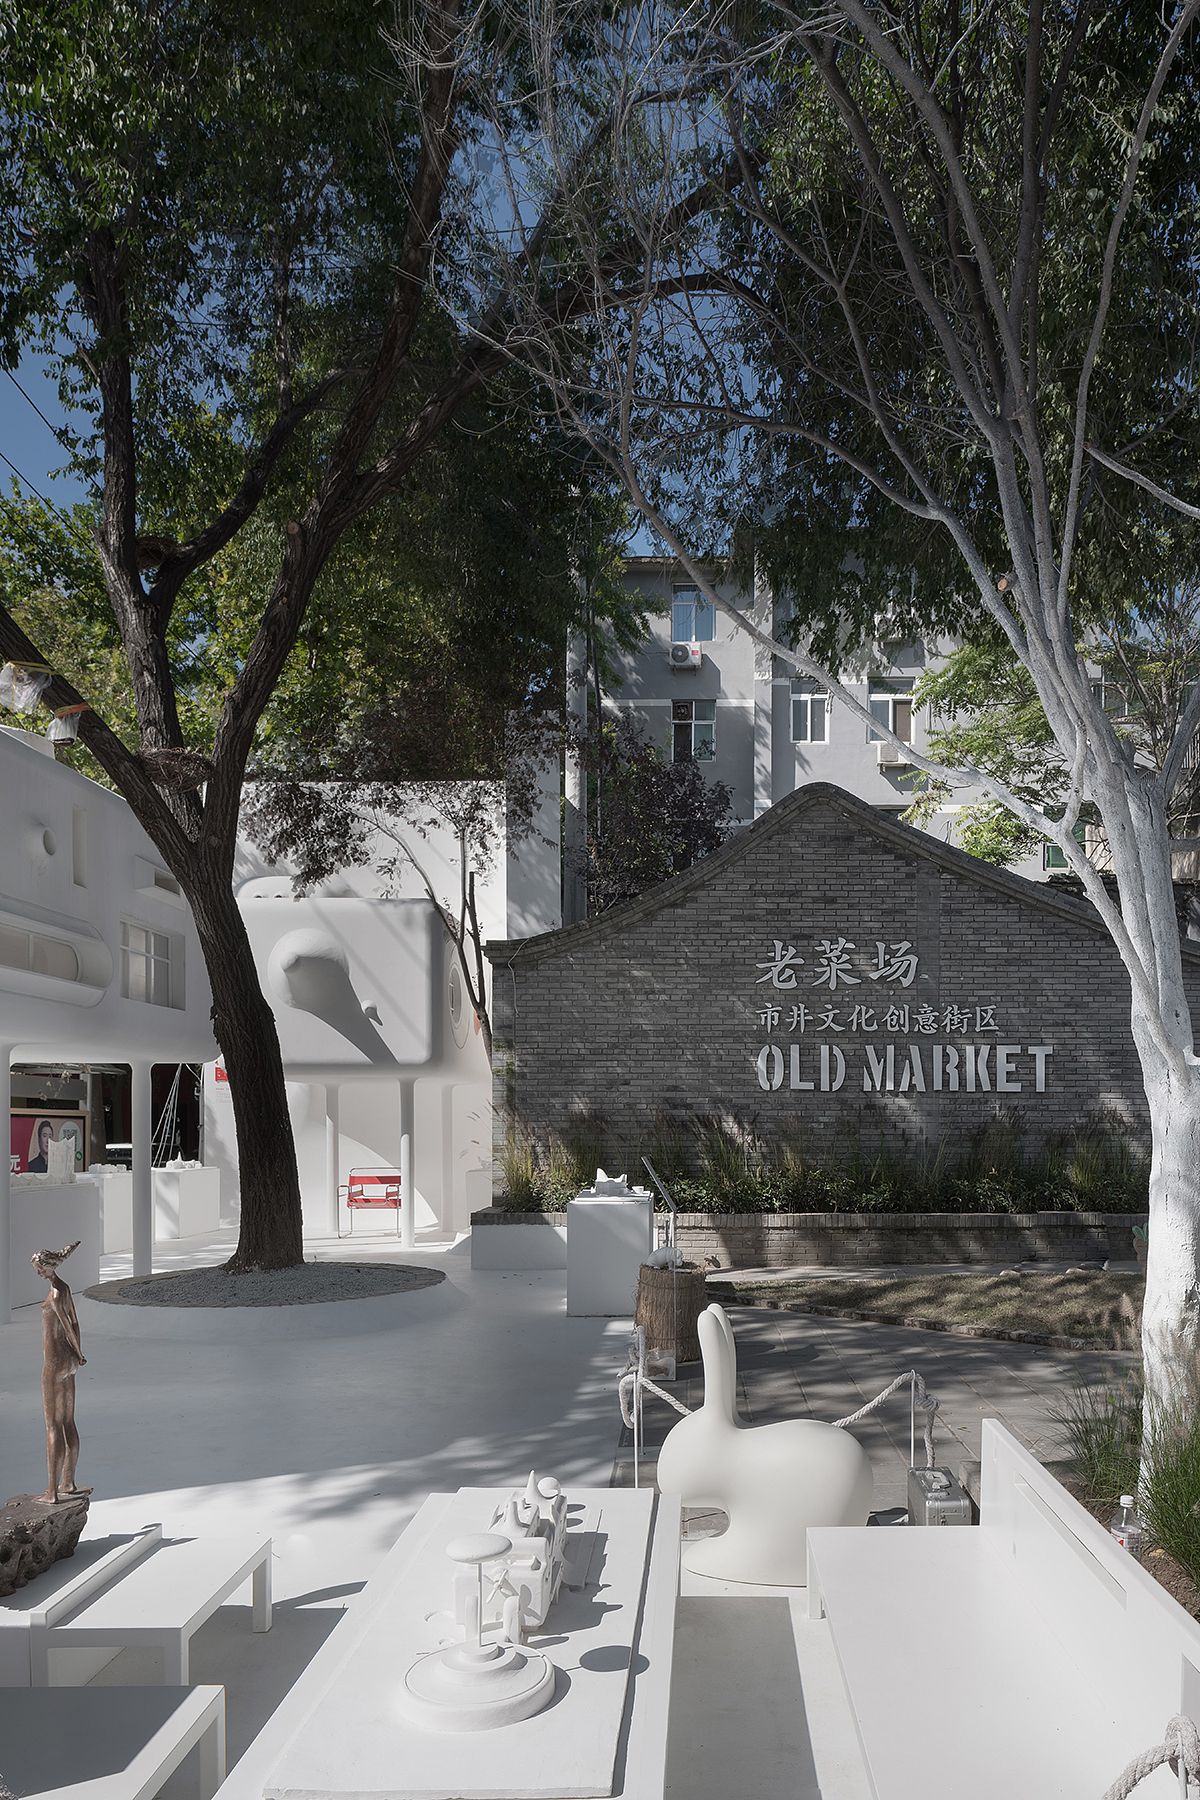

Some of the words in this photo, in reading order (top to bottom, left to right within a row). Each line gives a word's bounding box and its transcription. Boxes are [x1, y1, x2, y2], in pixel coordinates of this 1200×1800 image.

[755, 936, 919, 991] 老菜场
[755, 1002, 1000, 1034] 市井文化创意街区
[757, 1044, 846, 1091] OLD
[863, 1044, 1053, 1092] MARKET
